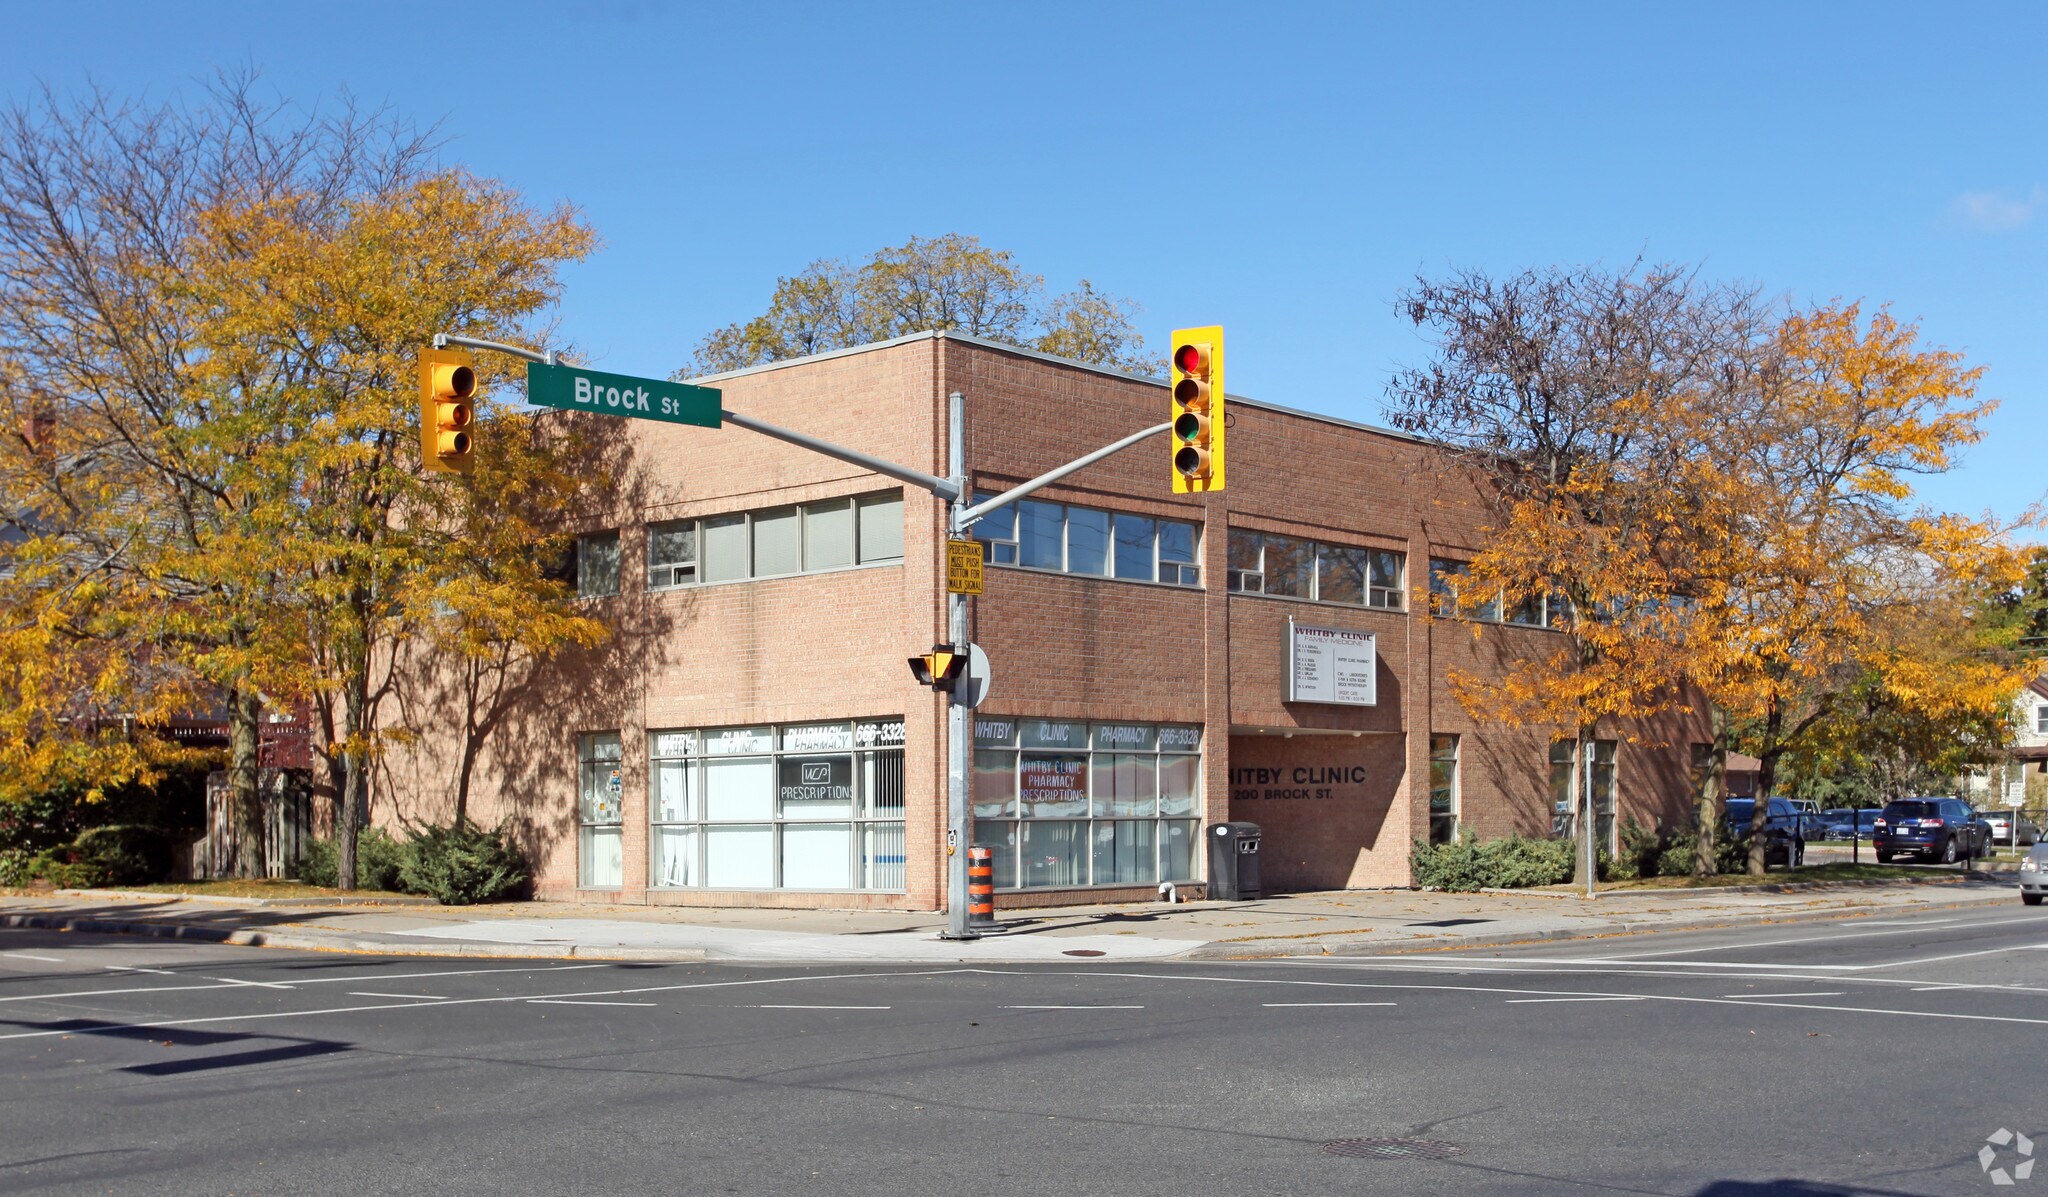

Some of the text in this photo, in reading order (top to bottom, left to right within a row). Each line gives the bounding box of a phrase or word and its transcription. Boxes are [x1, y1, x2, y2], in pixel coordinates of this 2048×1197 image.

[575, 376, 680, 415] Brock St
[949, 544, 981, 556] PEDESTRIANS
[951, 556, 980, 567] MUST PUSH
[950, 567, 981, 579] BUTTON FOR
[949, 579, 981, 590] WALK SIGNAL
[1295, 627, 1374, 641] WHITBY CLINIC
[1304, 636, 1364, 647] FAMILY MEDICINE
[658, 733, 692, 751] WHITBY
[721, 730, 752, 748] CLINIC
[788, 726, 843, 745] PHARMACY
[975, 721, 1199, 745] WHITBY CLINIC PHARMACY 666-3328
[1020, 760, 1082, 774] WHITBY CLINIC
[1028, 774, 1075, 787] PHARMACY
[1292, 766, 1366, 784] CLINIC
[1234, 789, 1334, 800] 200 BROCK ST.
